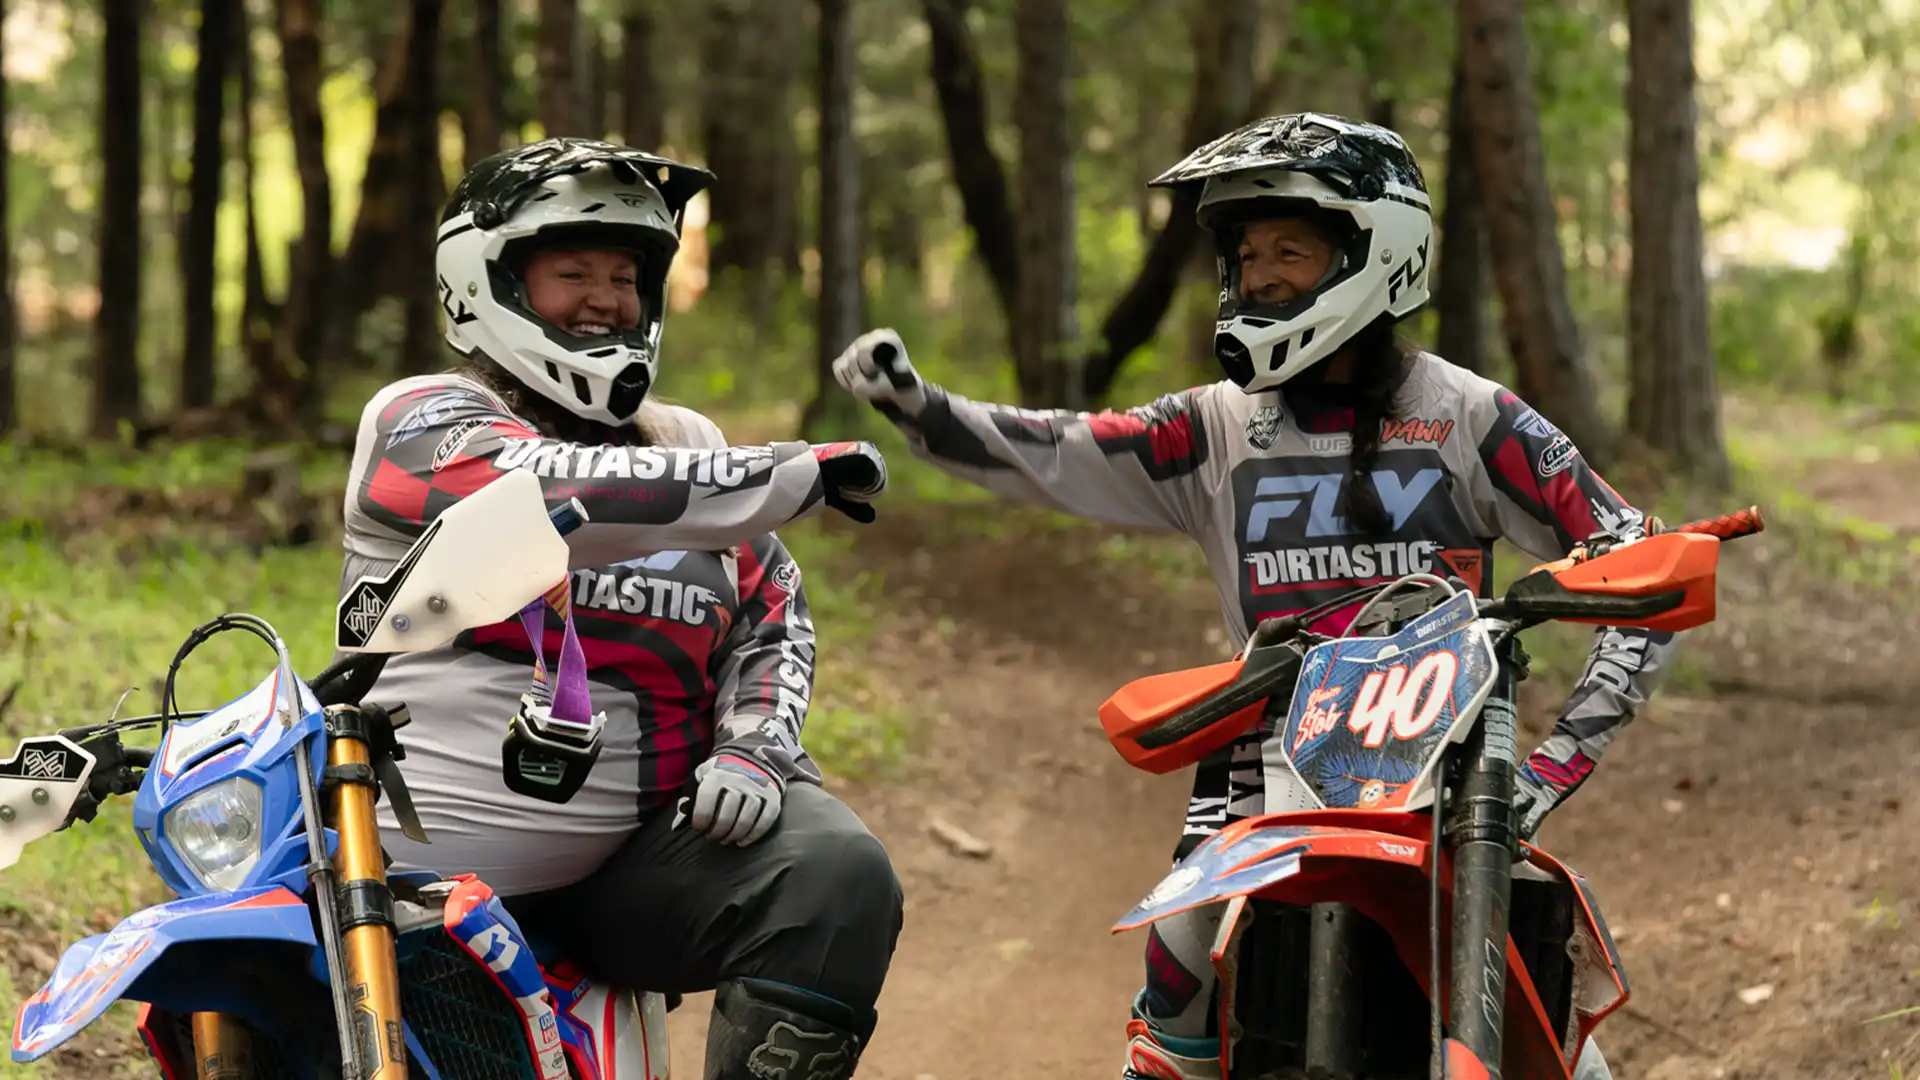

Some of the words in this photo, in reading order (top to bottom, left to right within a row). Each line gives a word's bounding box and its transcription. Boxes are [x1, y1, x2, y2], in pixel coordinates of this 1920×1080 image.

[1388, 233, 1429, 306] FLY
[1381, 416, 1455, 449] DAWN
[494, 436, 768, 487] DIRTASTIC
[1246, 468, 1443, 542] FLY
[1247, 540, 1440, 586] DIRTASTIC
[570, 568, 718, 626] TASTIC
[1347, 650, 1459, 749] 40
[1183, 796, 1227, 836] FLY
